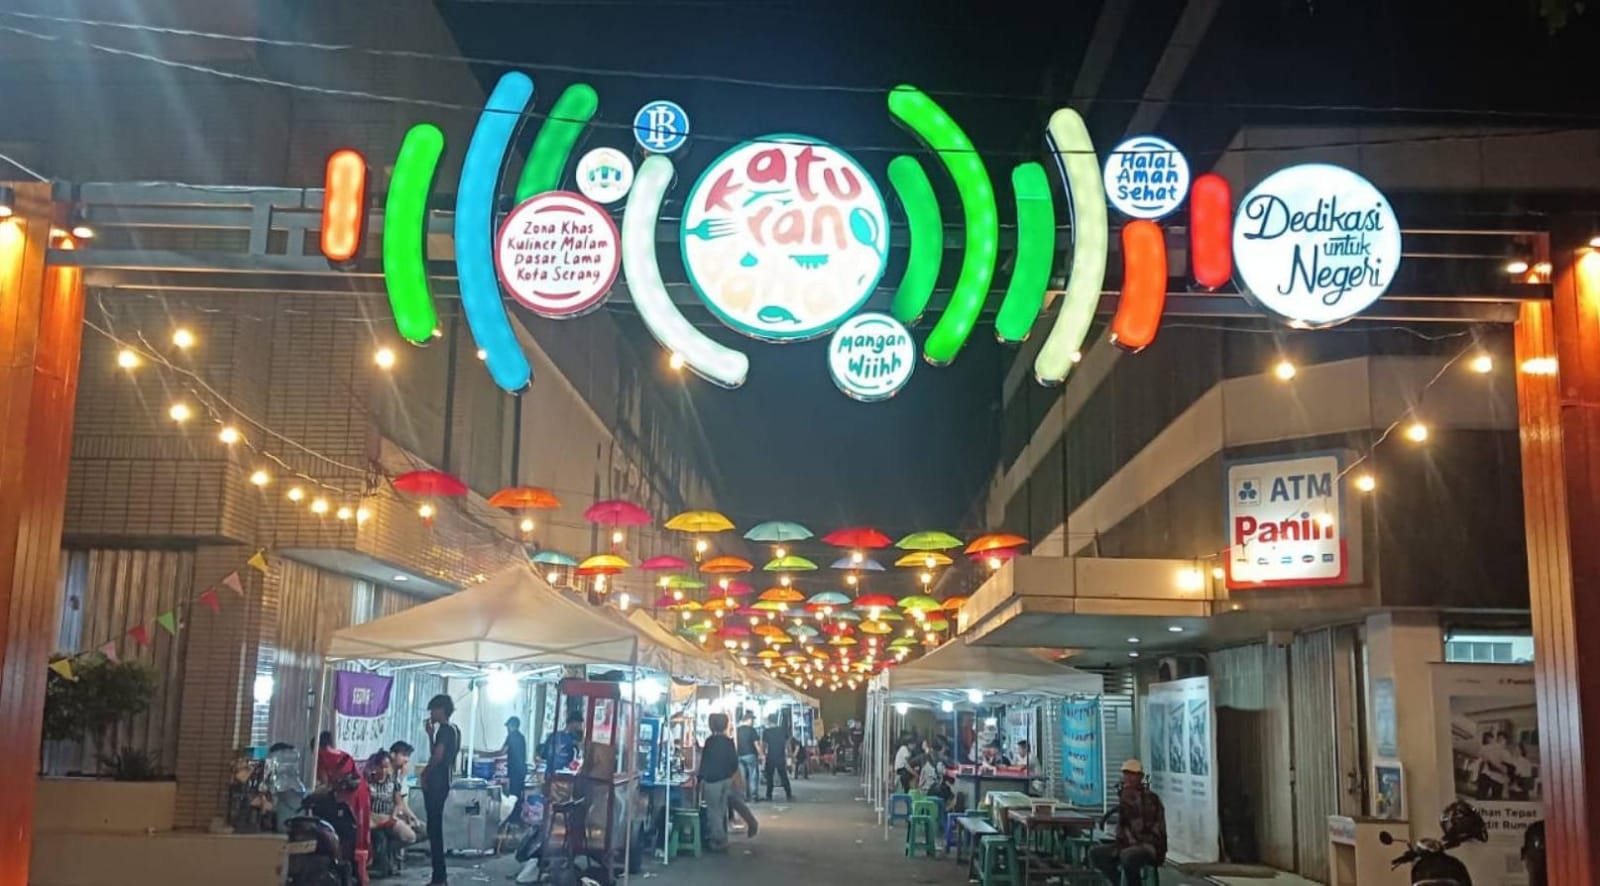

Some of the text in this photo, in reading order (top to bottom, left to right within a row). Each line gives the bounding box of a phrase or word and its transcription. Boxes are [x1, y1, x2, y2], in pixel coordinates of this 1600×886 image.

[1116, 168, 1178, 183] Aman
[1117, 184, 1177, 201] Sehat
[1244, 194, 1384, 240] Dedikasi
[523, 220, 594, 235] Zona Khas
[507, 235, 608, 252] Kuliner Malam
[1323, 232, 1371, 256] untuk
[563, 250, 601, 265] Lama
[517, 266, 601, 285] Kota Serang
[1277, 244, 1384, 306] Negeri
[1270, 472, 1333, 503] ATM
